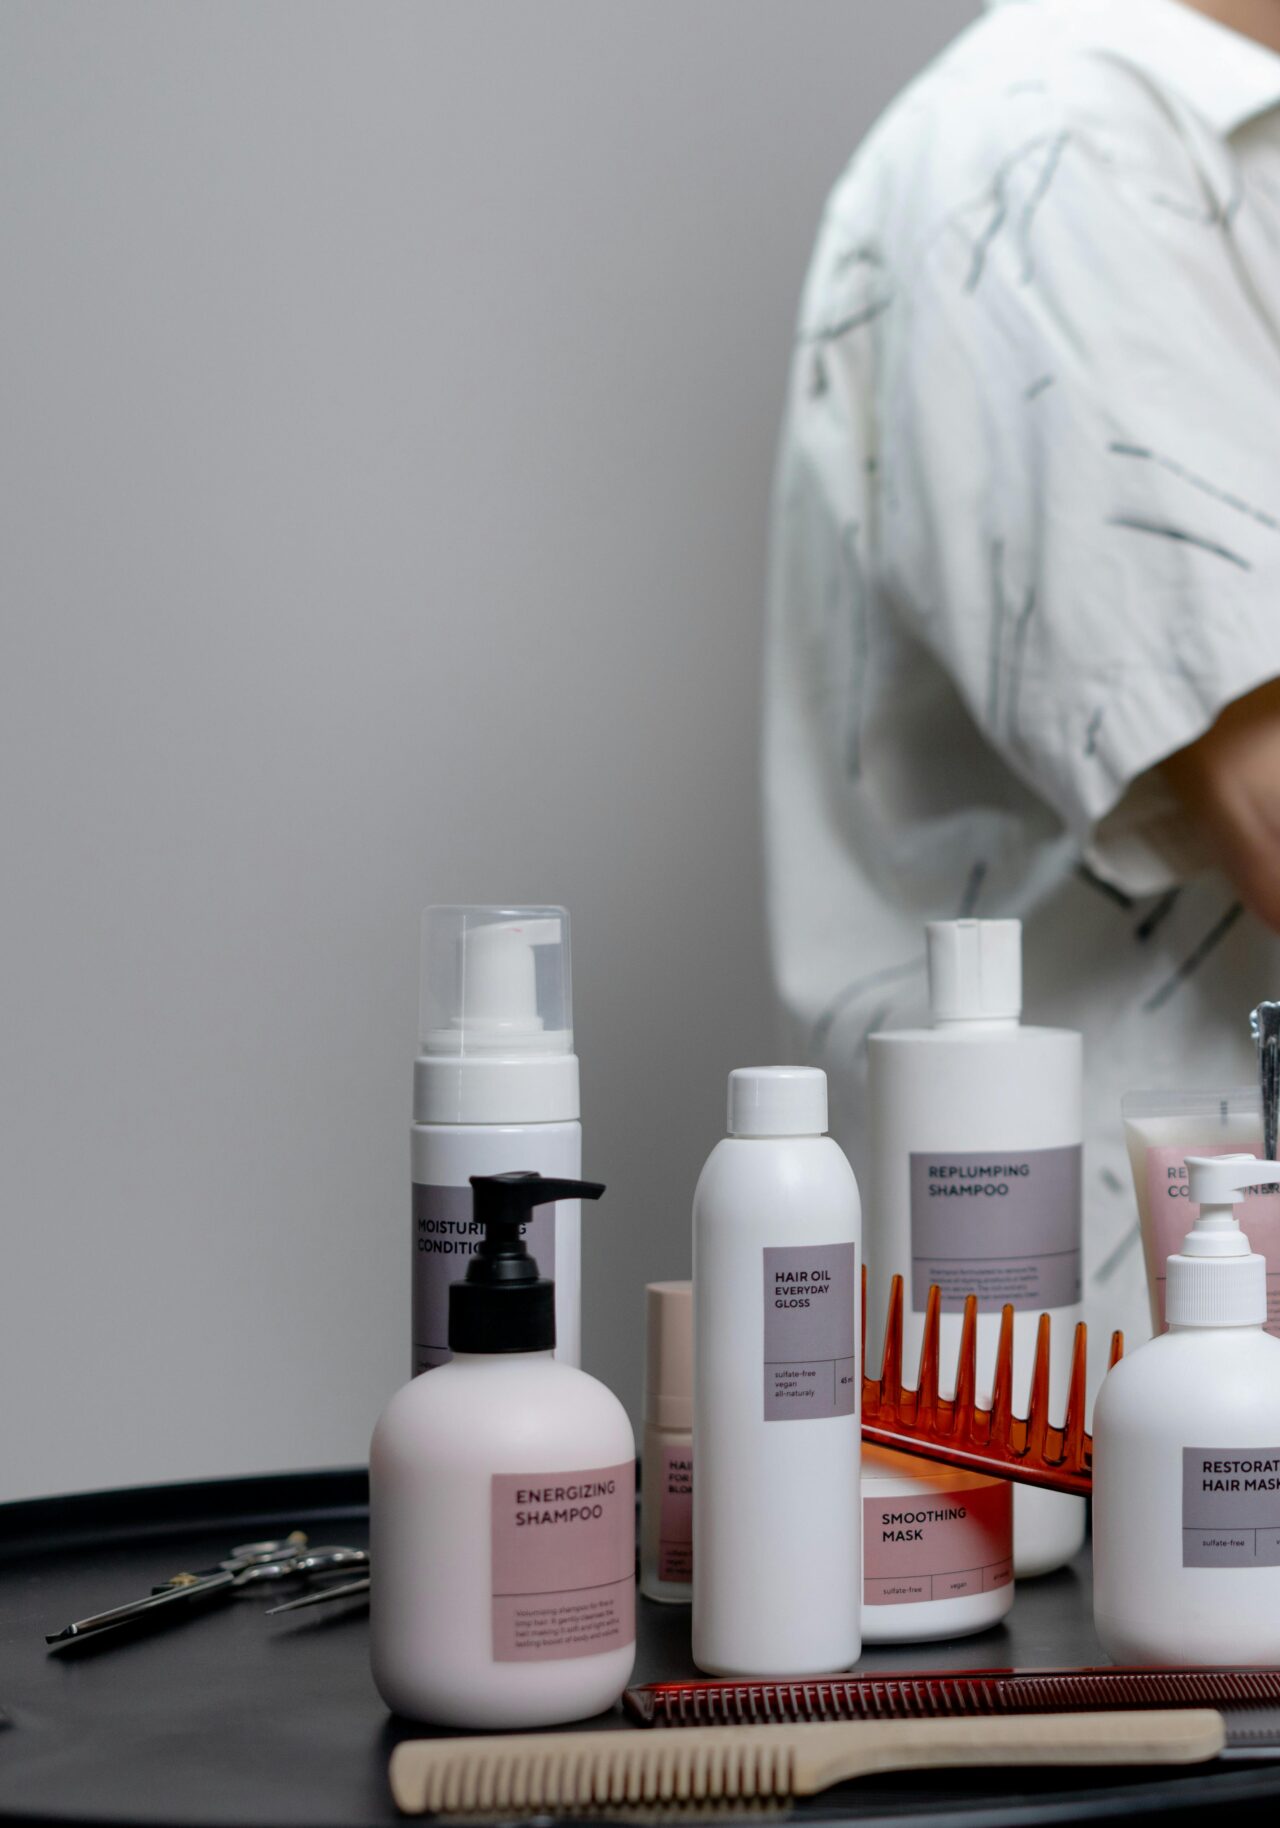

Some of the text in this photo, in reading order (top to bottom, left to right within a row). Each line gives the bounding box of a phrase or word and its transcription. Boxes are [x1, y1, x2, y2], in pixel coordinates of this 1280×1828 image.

[928, 1163, 1030, 1179] REPLUMPING
[928, 1183, 1010, 1198] SHAMPOO
[417, 1219, 527, 1236] MOISTURIG
[775, 1270, 832, 1283] HAIR OIL
[774, 1284, 830, 1296] EVERYDAY
[774, 1298, 811, 1309] GLOSS
[774, 1370, 817, 1379] sulfate-free
[774, 1381, 798, 1390] vegan
[515, 1479, 616, 1505] ENERGIZING
[1202, 1479, 1241, 1492] HAIR
[515, 1504, 604, 1527] SHAMPOO
[881, 1507, 967, 1525] SMOOTHING
[881, 1528, 924, 1543] MASK
[1202, 1539, 1245, 1547] sulfate-free
[882, 1585, 923, 1596] sulfate-free
[949, 1581, 968, 1590] vegan
